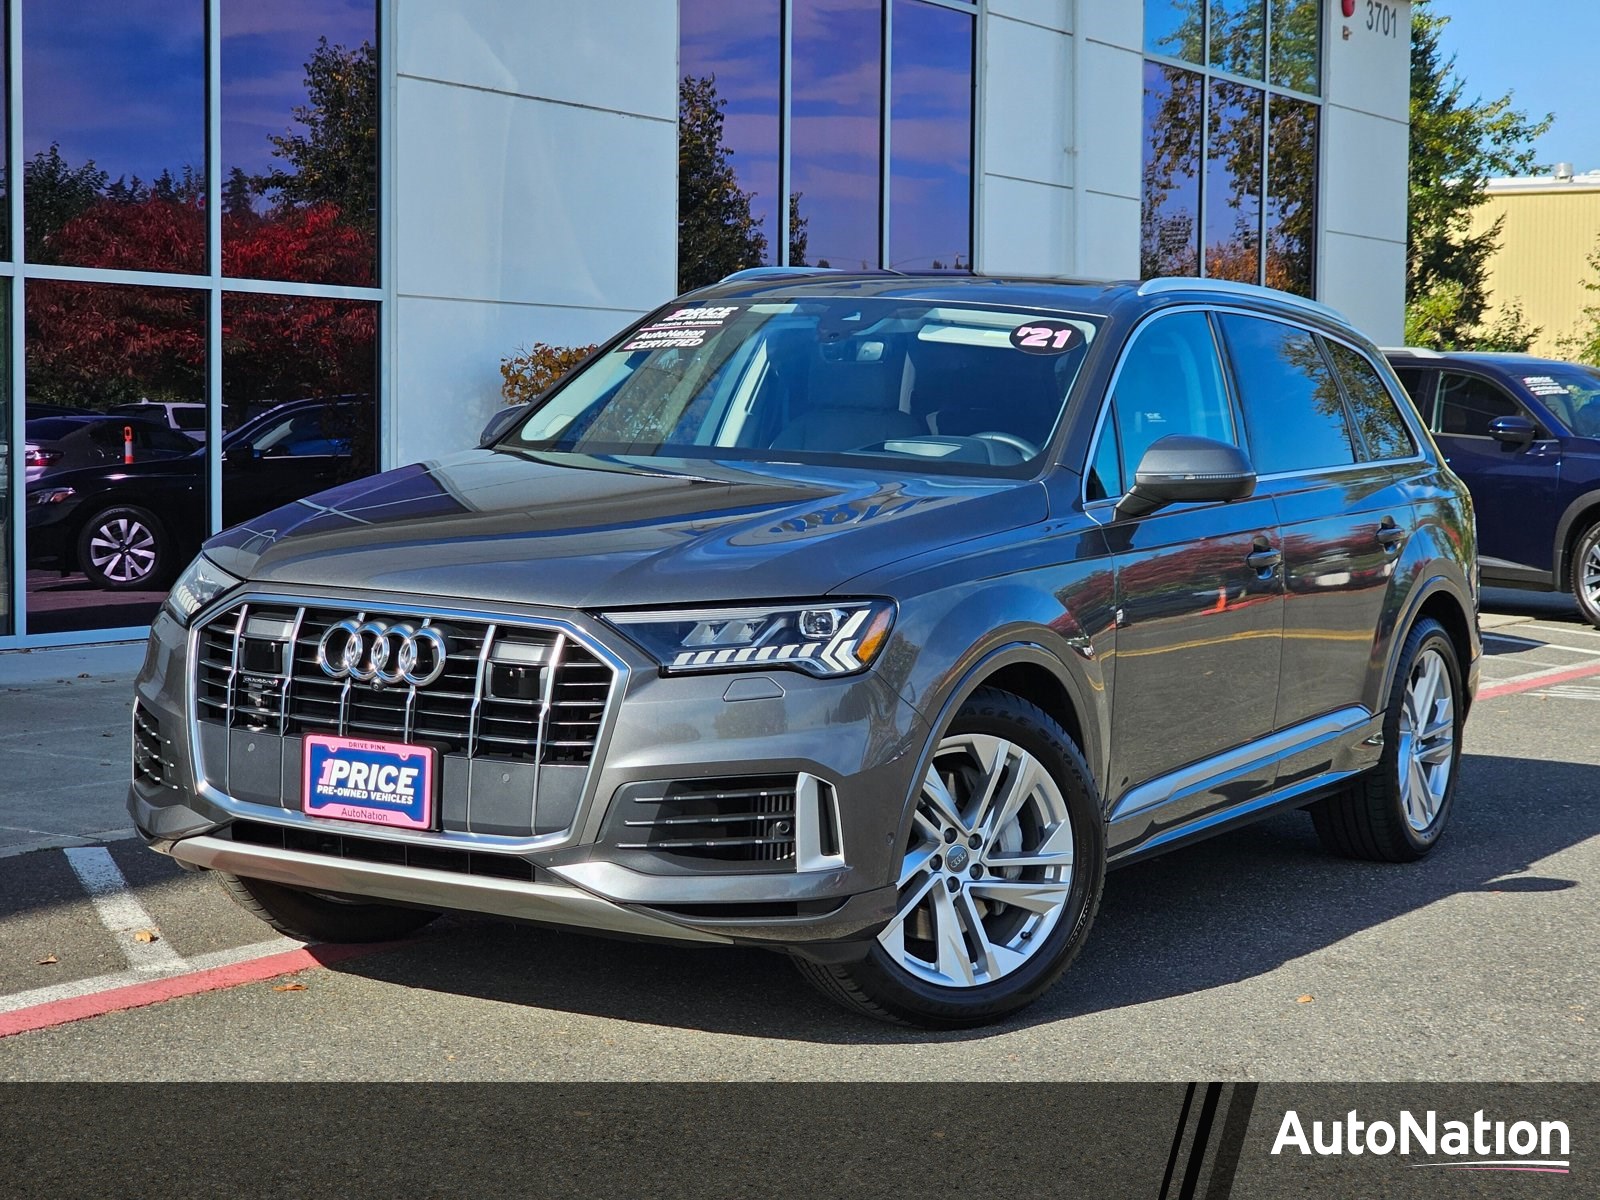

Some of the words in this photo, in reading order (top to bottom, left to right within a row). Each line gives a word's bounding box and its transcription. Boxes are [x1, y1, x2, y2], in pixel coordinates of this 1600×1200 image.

[1366, 0, 1397, 39] 3701
[635, 329, 707, 340] AutoNation
[626, 338, 704, 350] CERTIFIED
[348, 741, 368, 750] DRIVE
[370, 743, 386, 751] PINK
[316, 784, 369, 799] PRE-OWNED
[370, 791, 414, 805] VEHICLES
[341, 807, 388, 821] AutoNation
